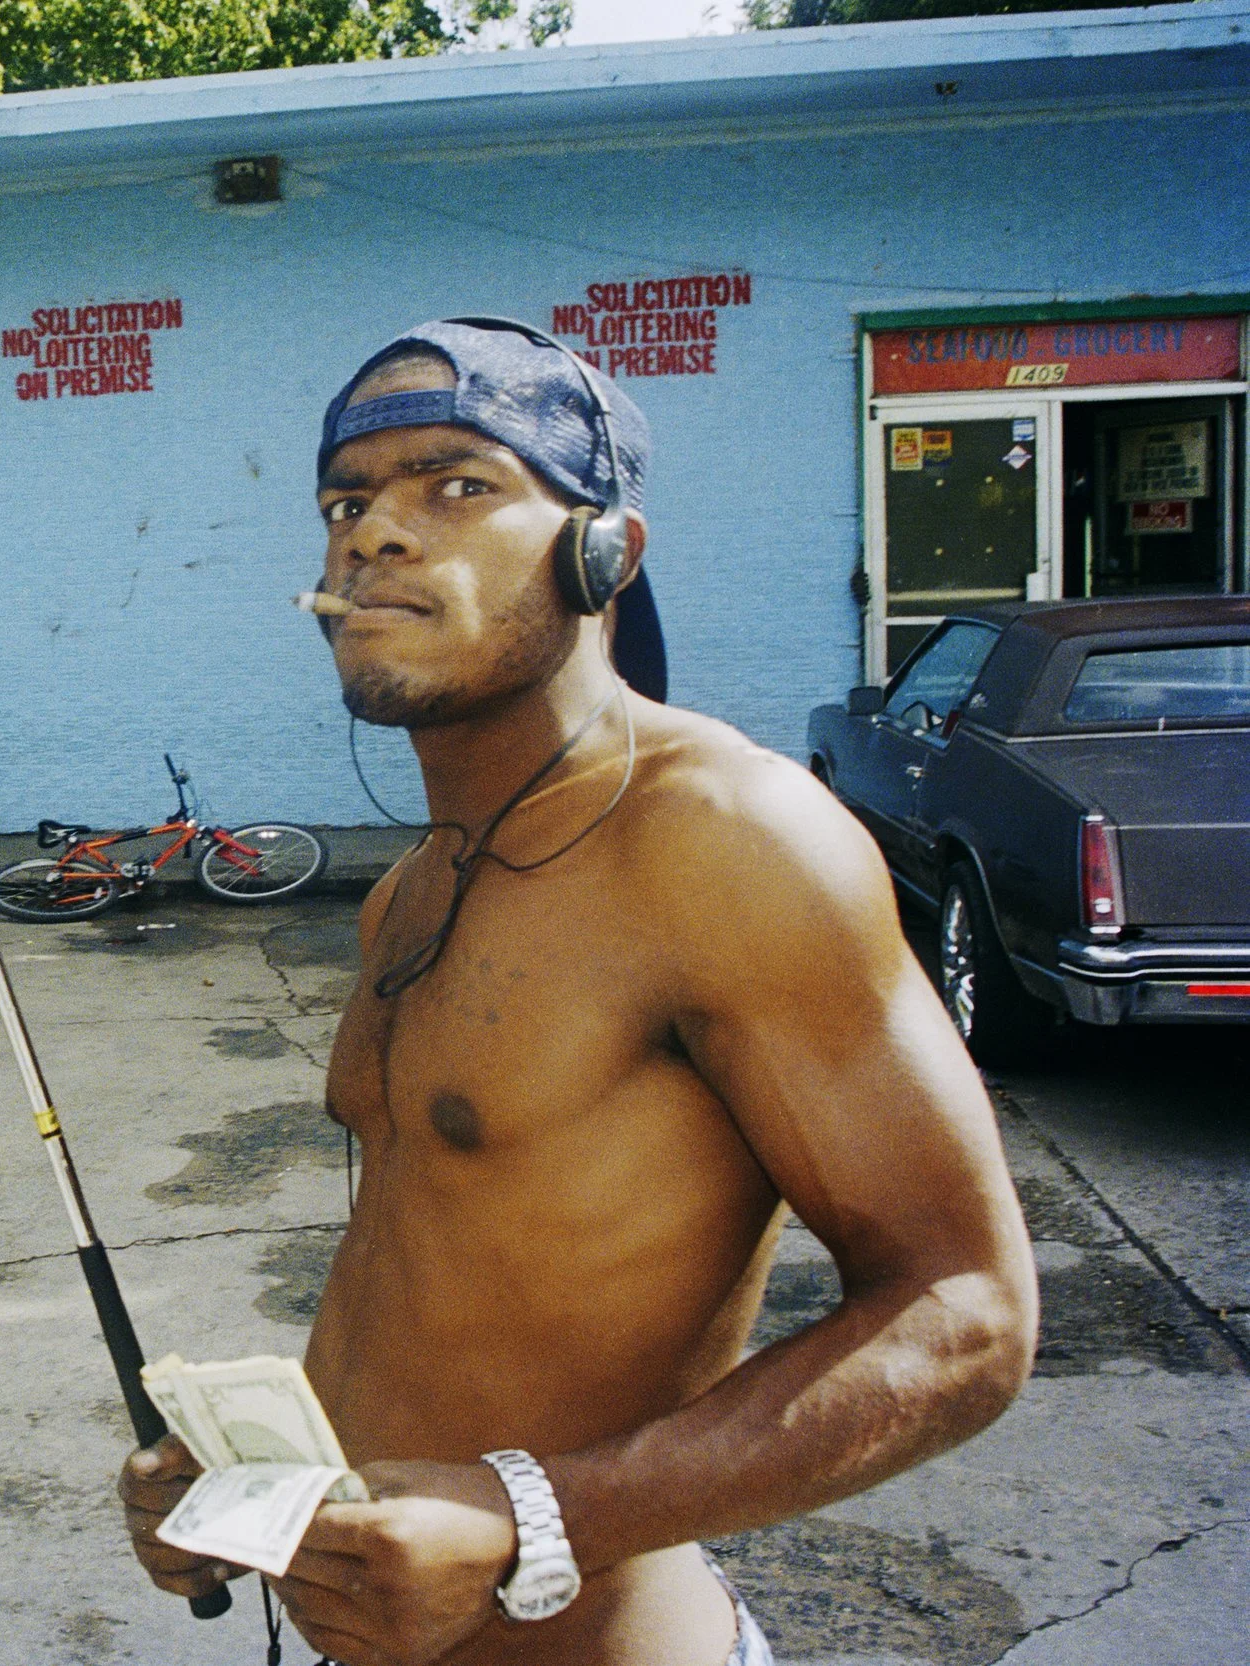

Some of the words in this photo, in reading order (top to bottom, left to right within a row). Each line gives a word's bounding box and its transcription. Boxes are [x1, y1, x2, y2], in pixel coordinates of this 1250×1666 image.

[586, 273, 751, 314] SOLICITATION
[32, 299, 182, 337] SOLICITATION
[553, 304, 584, 335] NO
[584, 309, 717, 347] LOITERING
[2, 328, 34, 357] NO
[33, 333, 152, 368] LOITERING
[609, 342, 717, 379] PREMISE
[908, 328, 1028, 364] SEAFOOD
[1053, 321, 1186, 358] GROCERY
[16, 371, 48, 401] ON
[55, 362, 153, 398] PREMISE
[1012, 364, 1066, 384] 1409
